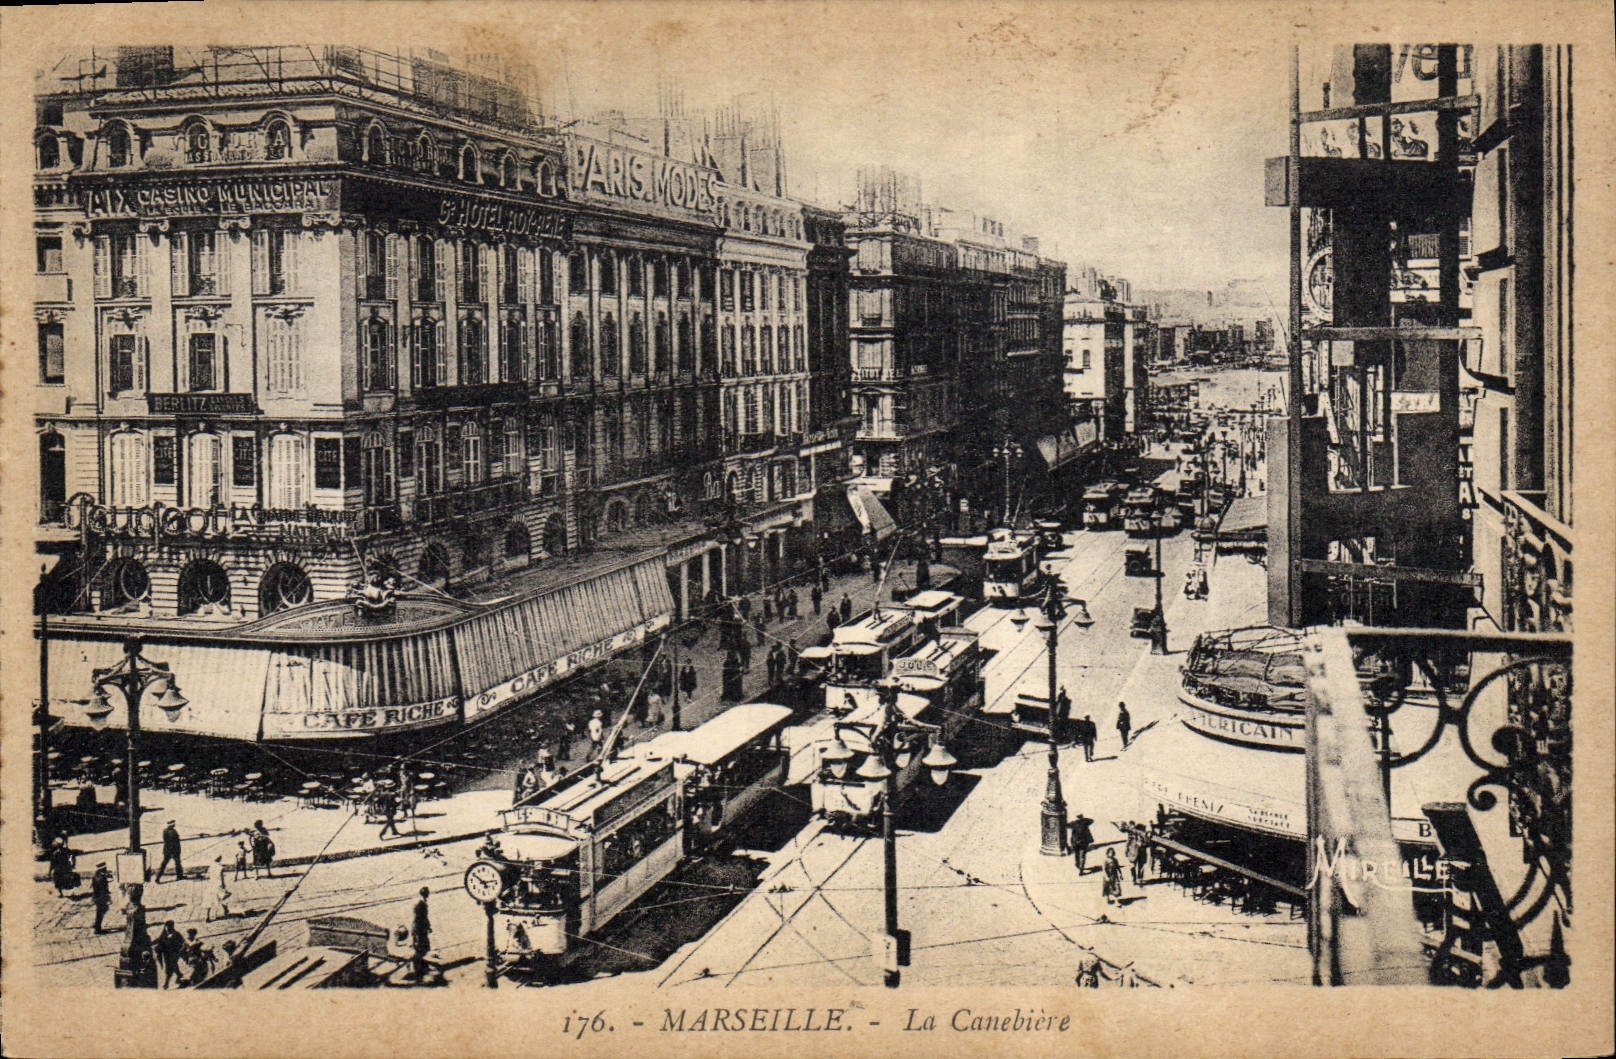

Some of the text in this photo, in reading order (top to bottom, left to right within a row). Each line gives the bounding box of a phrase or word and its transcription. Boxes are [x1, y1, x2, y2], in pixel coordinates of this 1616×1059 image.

[137, 185, 209, 206] CASINO
[217, 180, 330, 203] MUNICIPAL
[651, 158, 718, 213] MODES
[153, 395, 207, 412] BERLITZ
[510, 637, 615, 694] CAFE RICHE
[303, 700, 445, 729] CAFE RICHE
